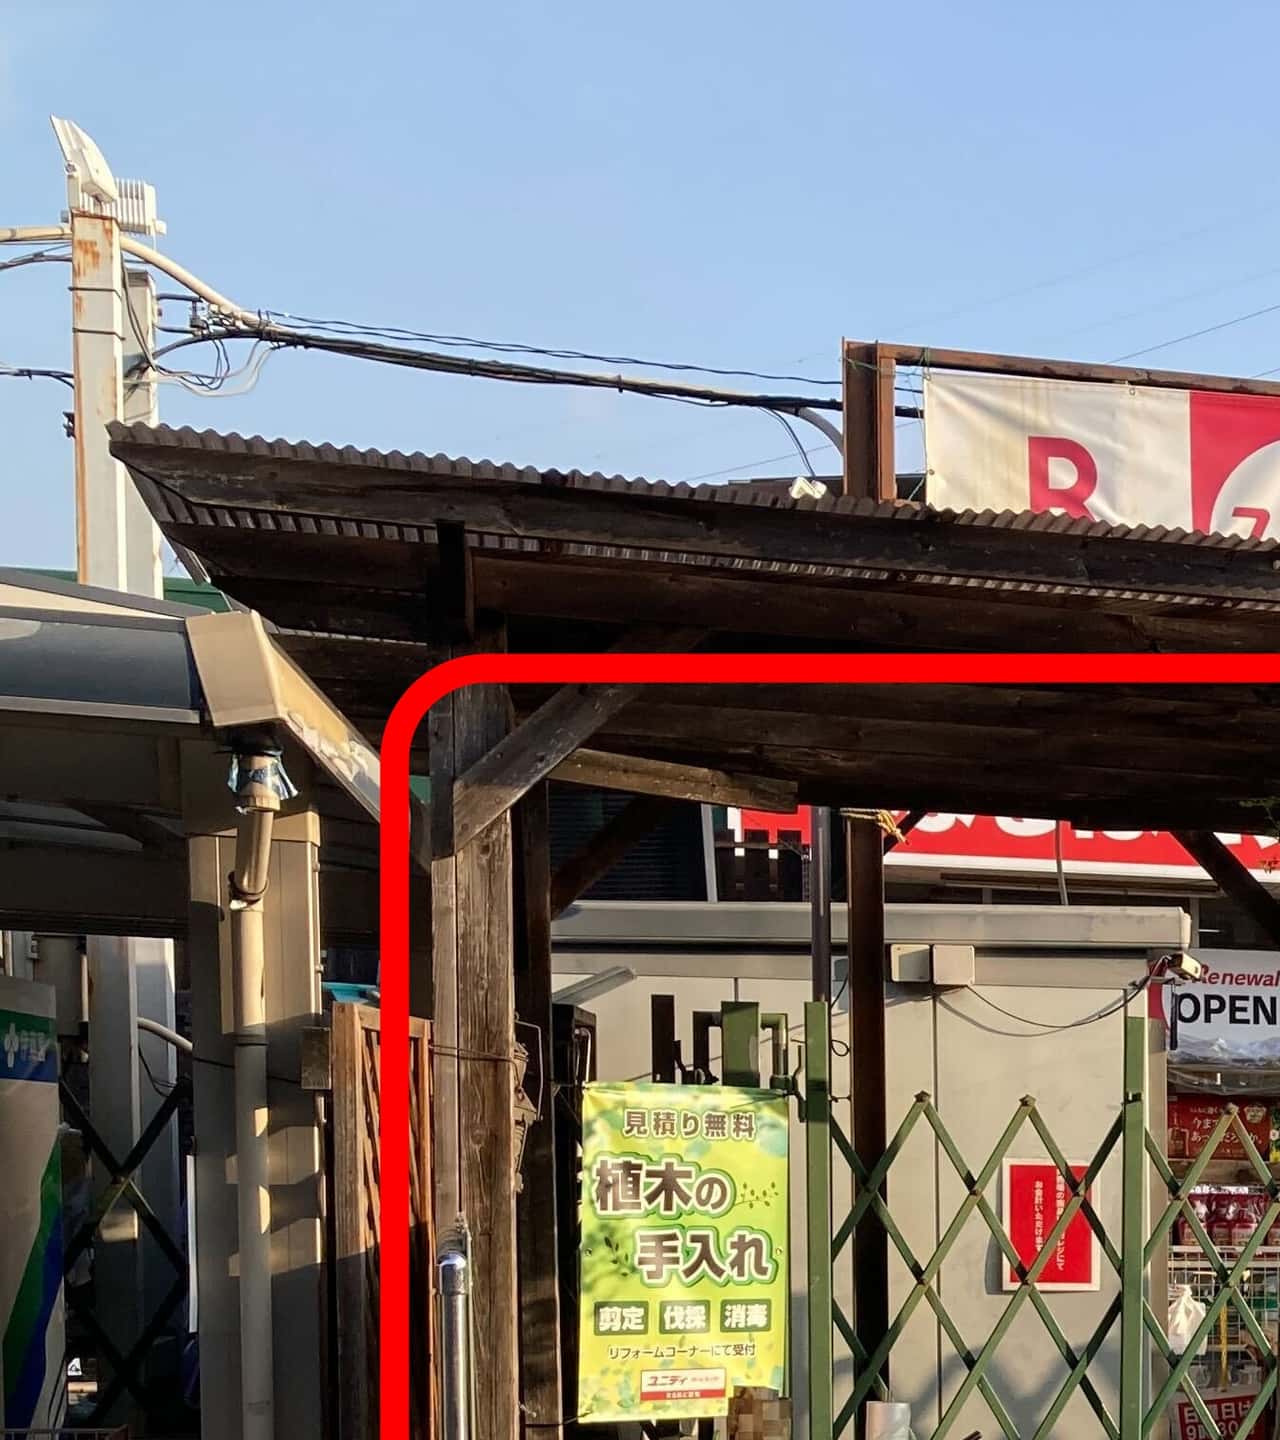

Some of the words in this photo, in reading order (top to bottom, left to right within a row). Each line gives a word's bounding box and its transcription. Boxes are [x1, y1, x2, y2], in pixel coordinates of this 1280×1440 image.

[1028, 436, 1098, 521] R
[624, 1110, 756, 1139] 見積り無料
[594, 1159, 728, 1213] 植木の
[638, 1231, 769, 1281] 手入れ
[599, 1307, 645, 1332] 剪定
[664, 1307, 706, 1331] 伐採
[724, 1304, 769, 1329] 消毒
[609, 1343, 756, 1360] リフォームコーナーにて受付
